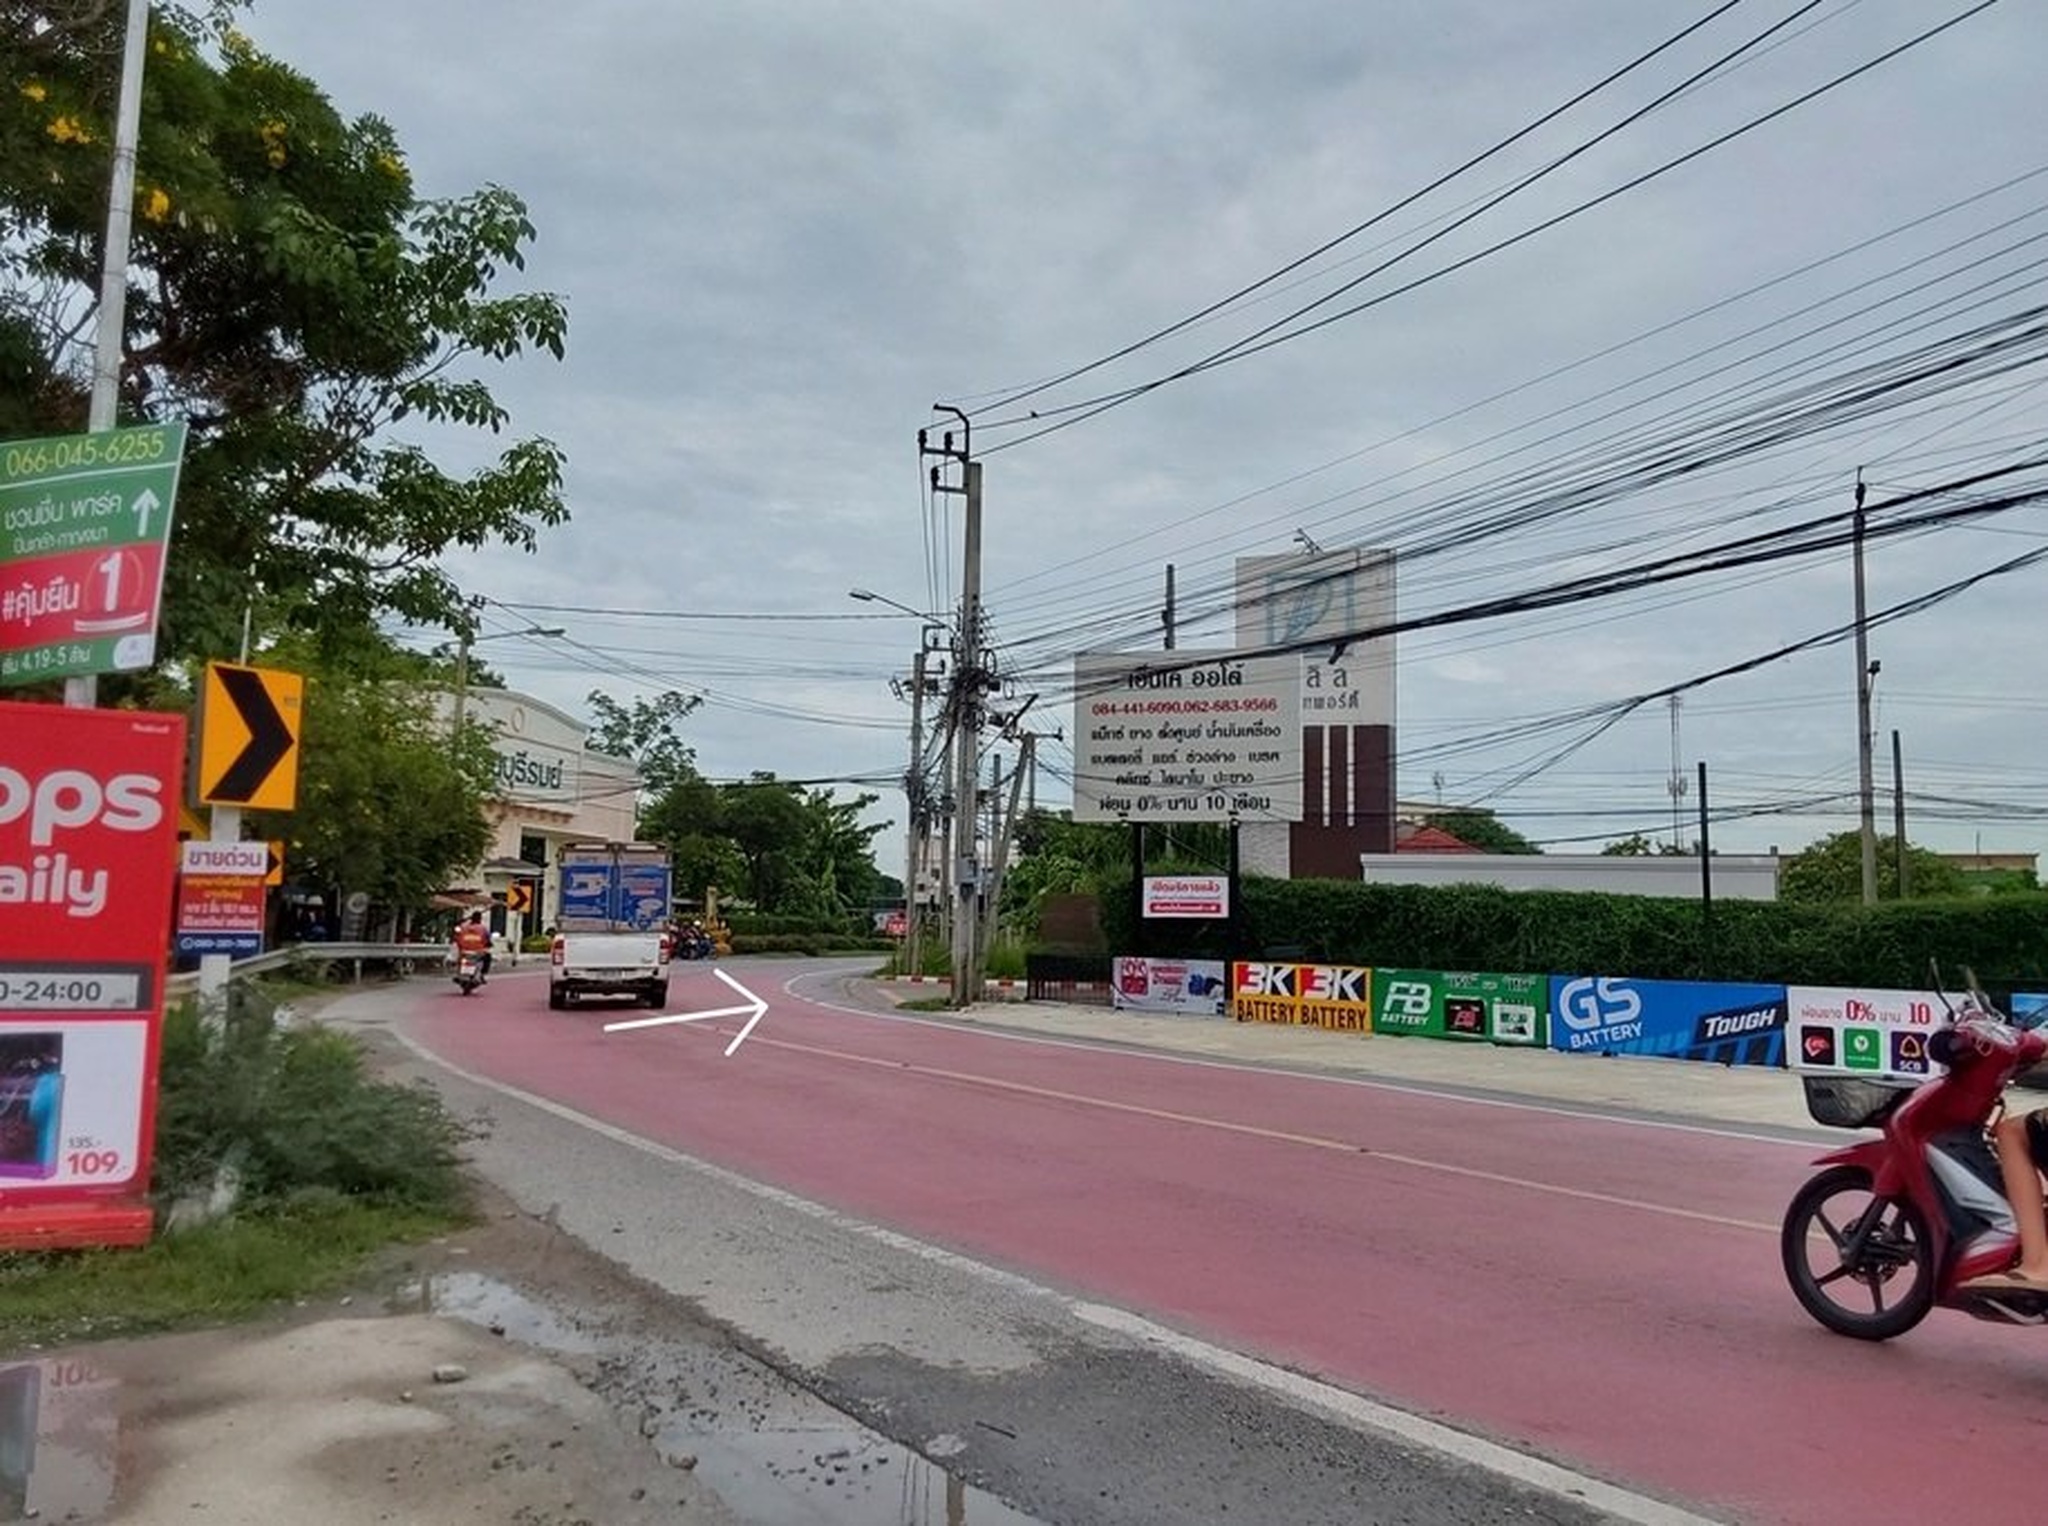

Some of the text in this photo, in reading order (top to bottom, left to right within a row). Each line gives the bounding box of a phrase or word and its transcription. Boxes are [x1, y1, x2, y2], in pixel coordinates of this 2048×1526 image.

[6, 431, 165, 477] 066-045-6255
[5, 491, 122, 530] ชวนชื่น พาร์ค
[3, 550, 123, 627] #คุ้มยืน 1
[1192, 660, 1245, 688] ออโต้
[1129, 728, 1153, 740] ยาง
[1137, 797, 1162, 811] 0%
[1168, 798, 1198, 811] นาน
[1207, 796, 1225, 810] 10
[189, 846, 262, 867] ขายด่วน
[1239, 962, 1365, 1002] 3K 3K
[1383, 981, 1432, 1015] FB
[1559, 976, 1642, 1031] GS
[1845, 1000, 1876, 1021] 0%
[1909, 1002, 1931, 1024] 10
[1236, 999, 1367, 1030] BATTERY BATTERY
[1381, 1013, 1430, 1026] BATTERY
[1704, 1008, 1777, 1039] TOUGH
[1569, 1022, 1643, 1049] BATTERY
